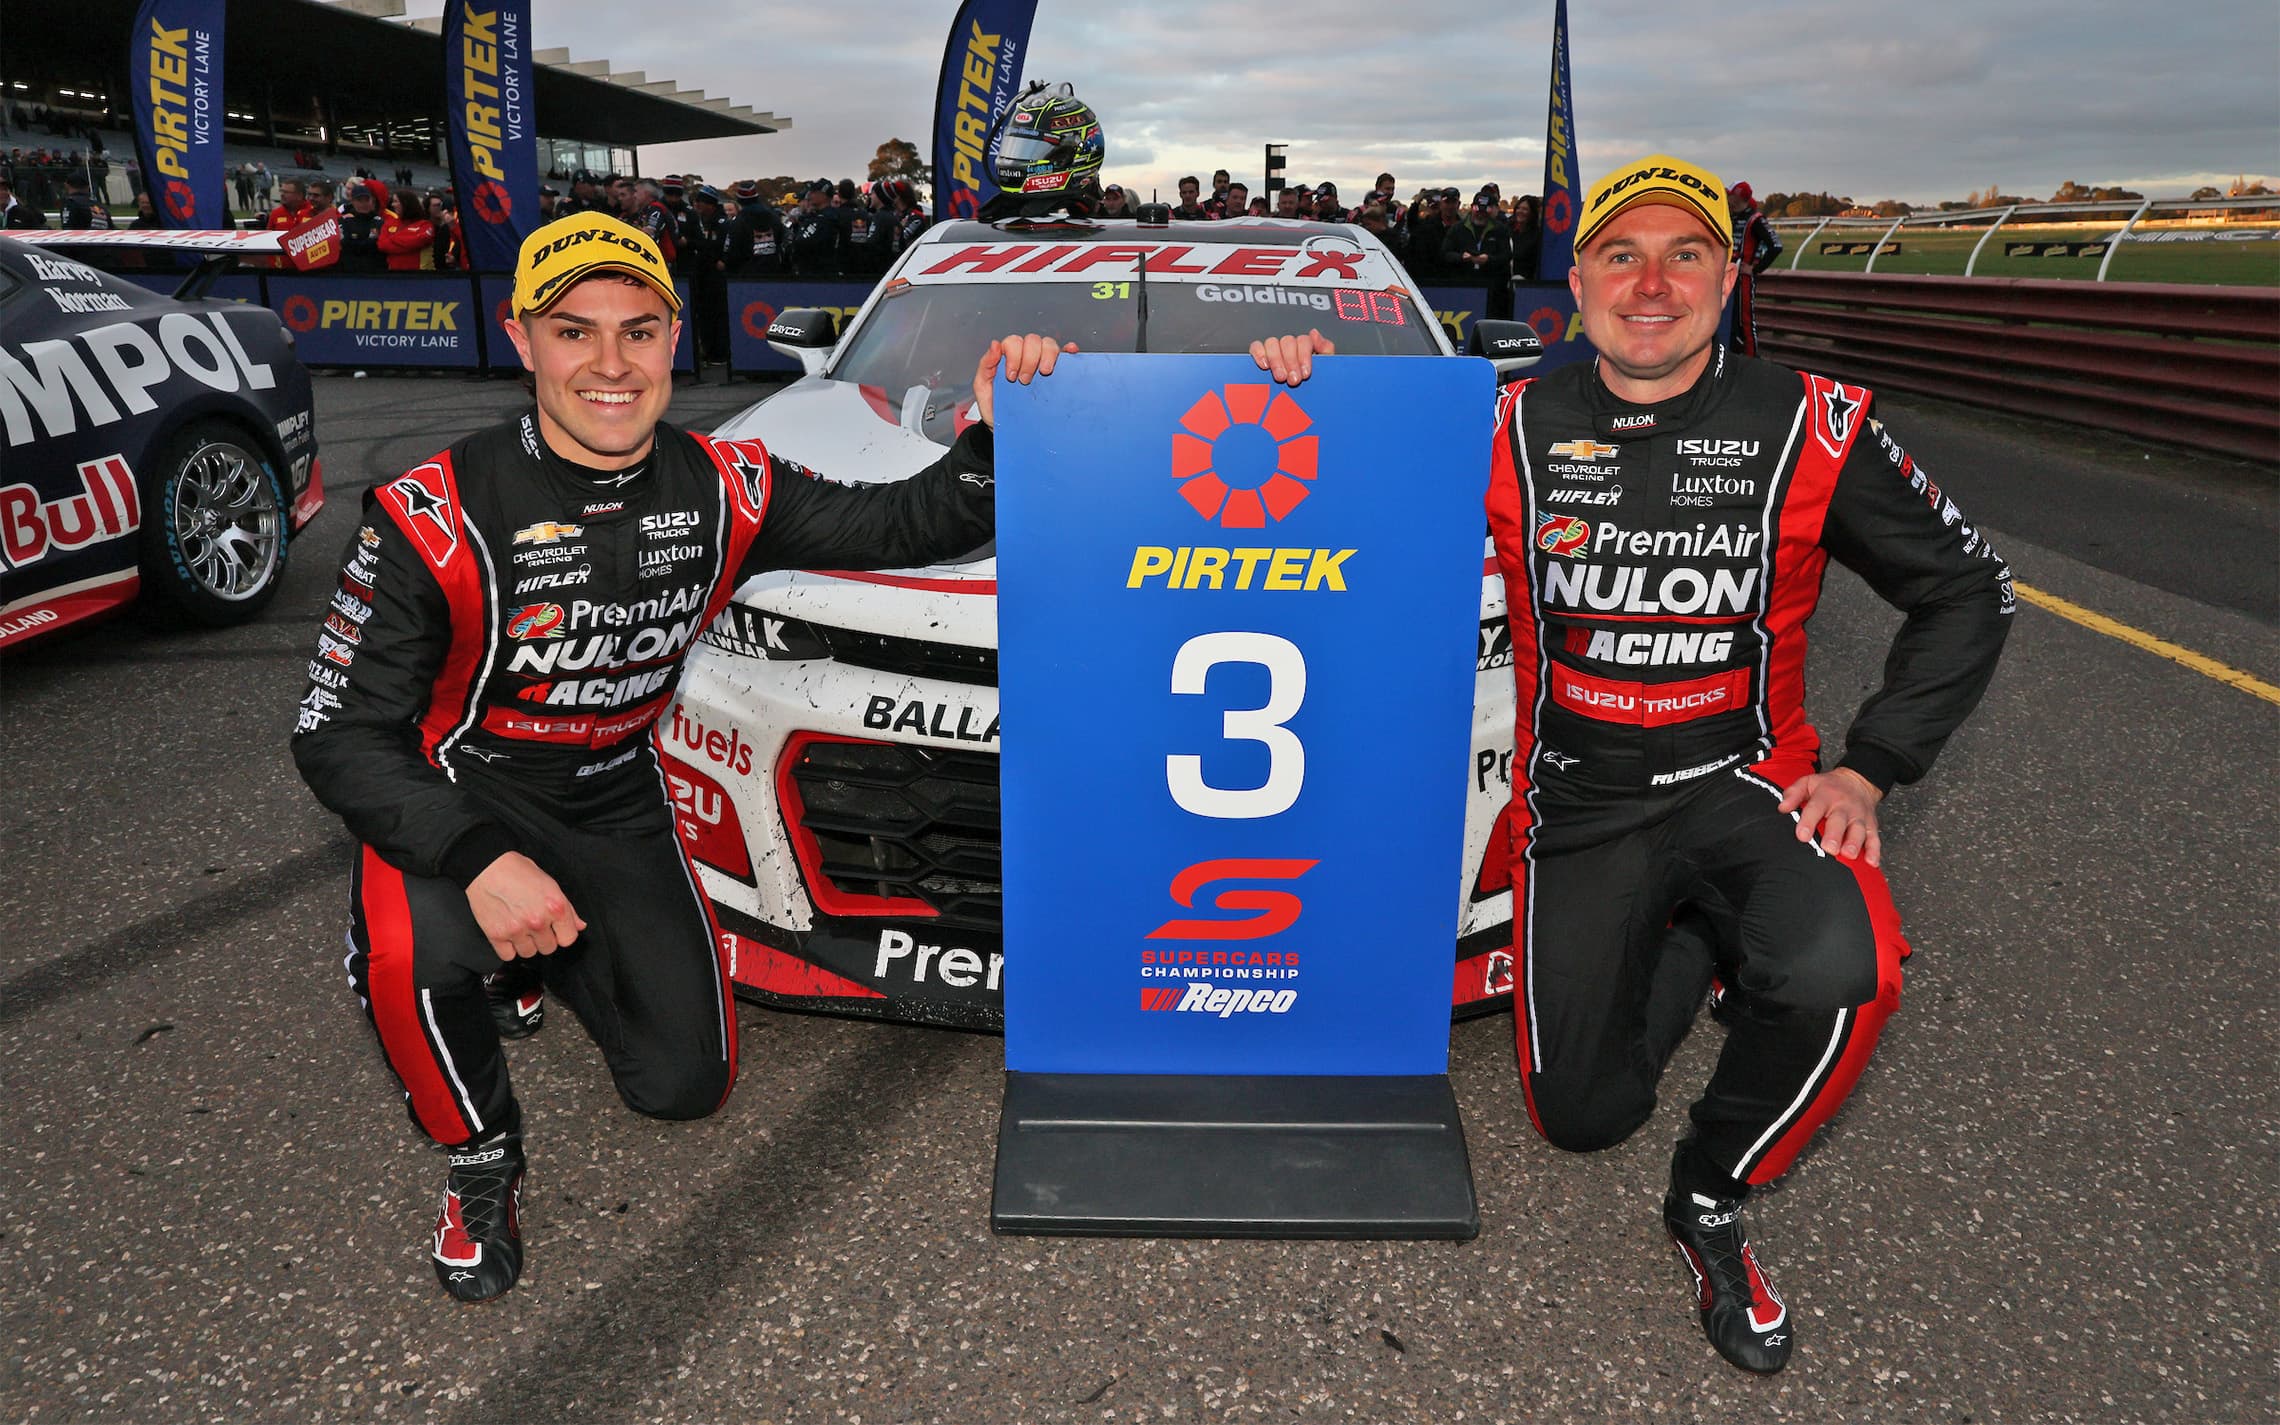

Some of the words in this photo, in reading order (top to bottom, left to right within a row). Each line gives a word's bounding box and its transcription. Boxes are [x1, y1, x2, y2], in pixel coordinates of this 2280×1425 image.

[504, 12, 517, 59] LANE
[197, 31, 210, 79] LANE
[998, 38, 1016, 84] LANE
[151, 17, 189, 179] PIRTEK
[464, 1, 505, 181] PIRTEK
[505, 64, 522, 141] VICTORY
[953, 19, 1001, 191] PIRTEK
[195, 84, 209, 145] VICTORY
[1031, 176, 1063, 186] ISUZU
[1590, 167, 1719, 213] DUNLOP
[288, 218, 337, 257] SUPERCHEAP
[310, 244, 327, 259] AUTO
[531, 229, 659, 270] DUNLOP
[24, 254, 102, 287] Harvey
[919, 244, 1366, 280] HIFLEX
[44, 288, 134, 313] Norman
[1091, 282, 1130, 299] 31
[1196, 284, 1332, 311] Golding
[321, 300, 458, 331] PIRTEK
[356, 334, 413, 347] VICTORY
[415, 335, 458, 347] LANE
[1613, 414, 1655, 429] NULON
[1676, 439, 1760, 457] ISUZU
[1689, 457, 1743, 467] TRUCKS
[1548, 464, 1621, 475] CHEVROLET
[1562, 474, 1604, 482] RACING
[1672, 473, 1755, 496] Luxton
[1, 455, 140, 565] Bull
[583, 502, 624, 513] NULON
[1547, 484, 1623, 506] HIFLEX
[1670, 496, 1713, 507] HOMES
[639, 511, 700, 533] ISUZU
[647, 528, 690, 540] TRUCKS
[513, 546, 588, 564] CHEVROLET
[1593, 522, 1760, 558] PremiAir
[528, 556, 572, 567] RACING
[639, 544, 703, 568] Luxton
[1126, 546, 1359, 591] PIRTEK
[514, 564, 591, 595] HIFLEX
[639, 565, 673, 580] HOMES
[1543, 560, 1760, 615] NULON
[571, 584, 706, 630] PremiAir
[0, 609, 58, 640] LLAND
[507, 615, 700, 674] NULON
[1564, 626, 1734, 666] RACING
[1566, 682, 1635, 711] ISUZU
[1642, 687, 1727, 714] TRUCKS
[507, 720, 587, 734] ISUZU
[672, 703, 753, 776] fuels
[1167, 632, 1307, 819] 3
[1141, 950, 1300, 966] SUPERCARS
[1141, 967, 1299, 979] CHAMPIONSHIP
[1176, 982, 1298, 1018] Repco
